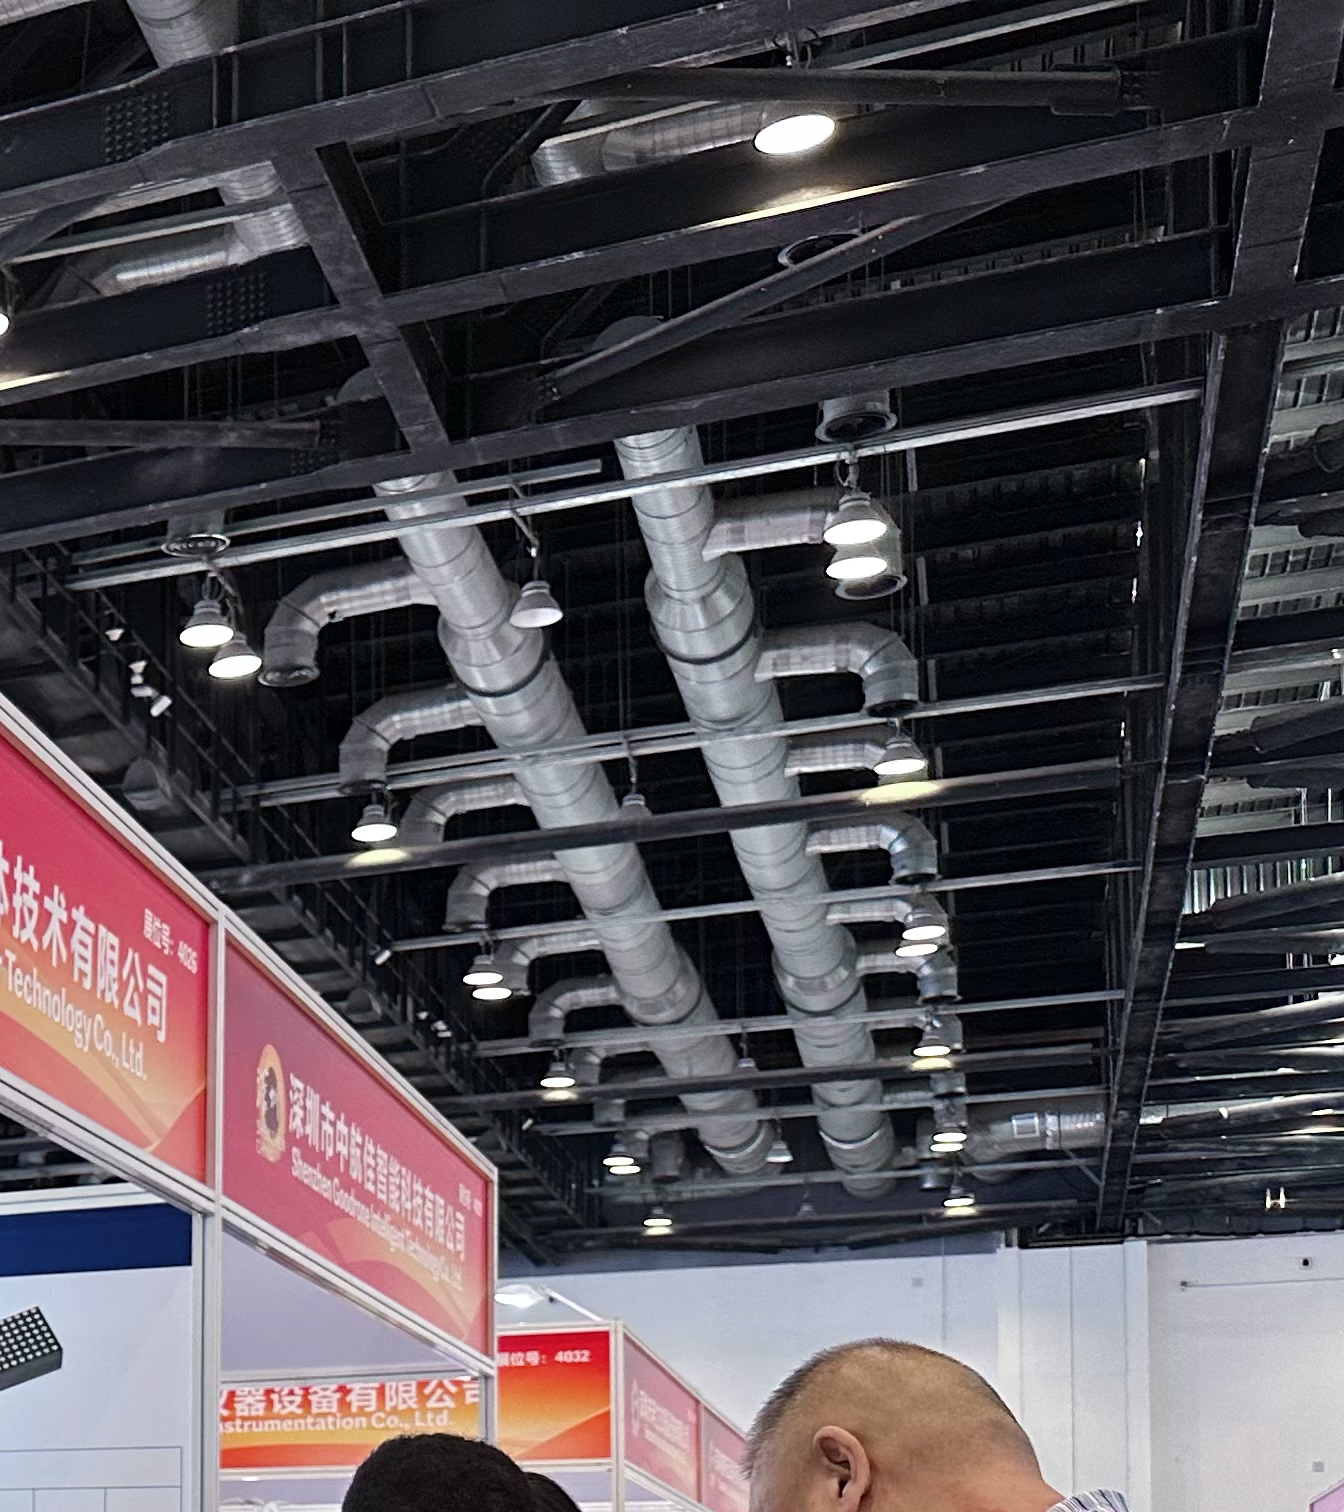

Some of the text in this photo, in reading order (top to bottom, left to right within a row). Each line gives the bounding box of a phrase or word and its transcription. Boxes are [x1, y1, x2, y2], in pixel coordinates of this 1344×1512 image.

[3, 946, 92, 1053] Technology
[92, 1010, 119, 1068] Co.,
[121, 1028, 148, 1082] Ltd.
[371, 1411, 411, 1430] Co.,
[415, 1411, 454, 1427] Ltd.
